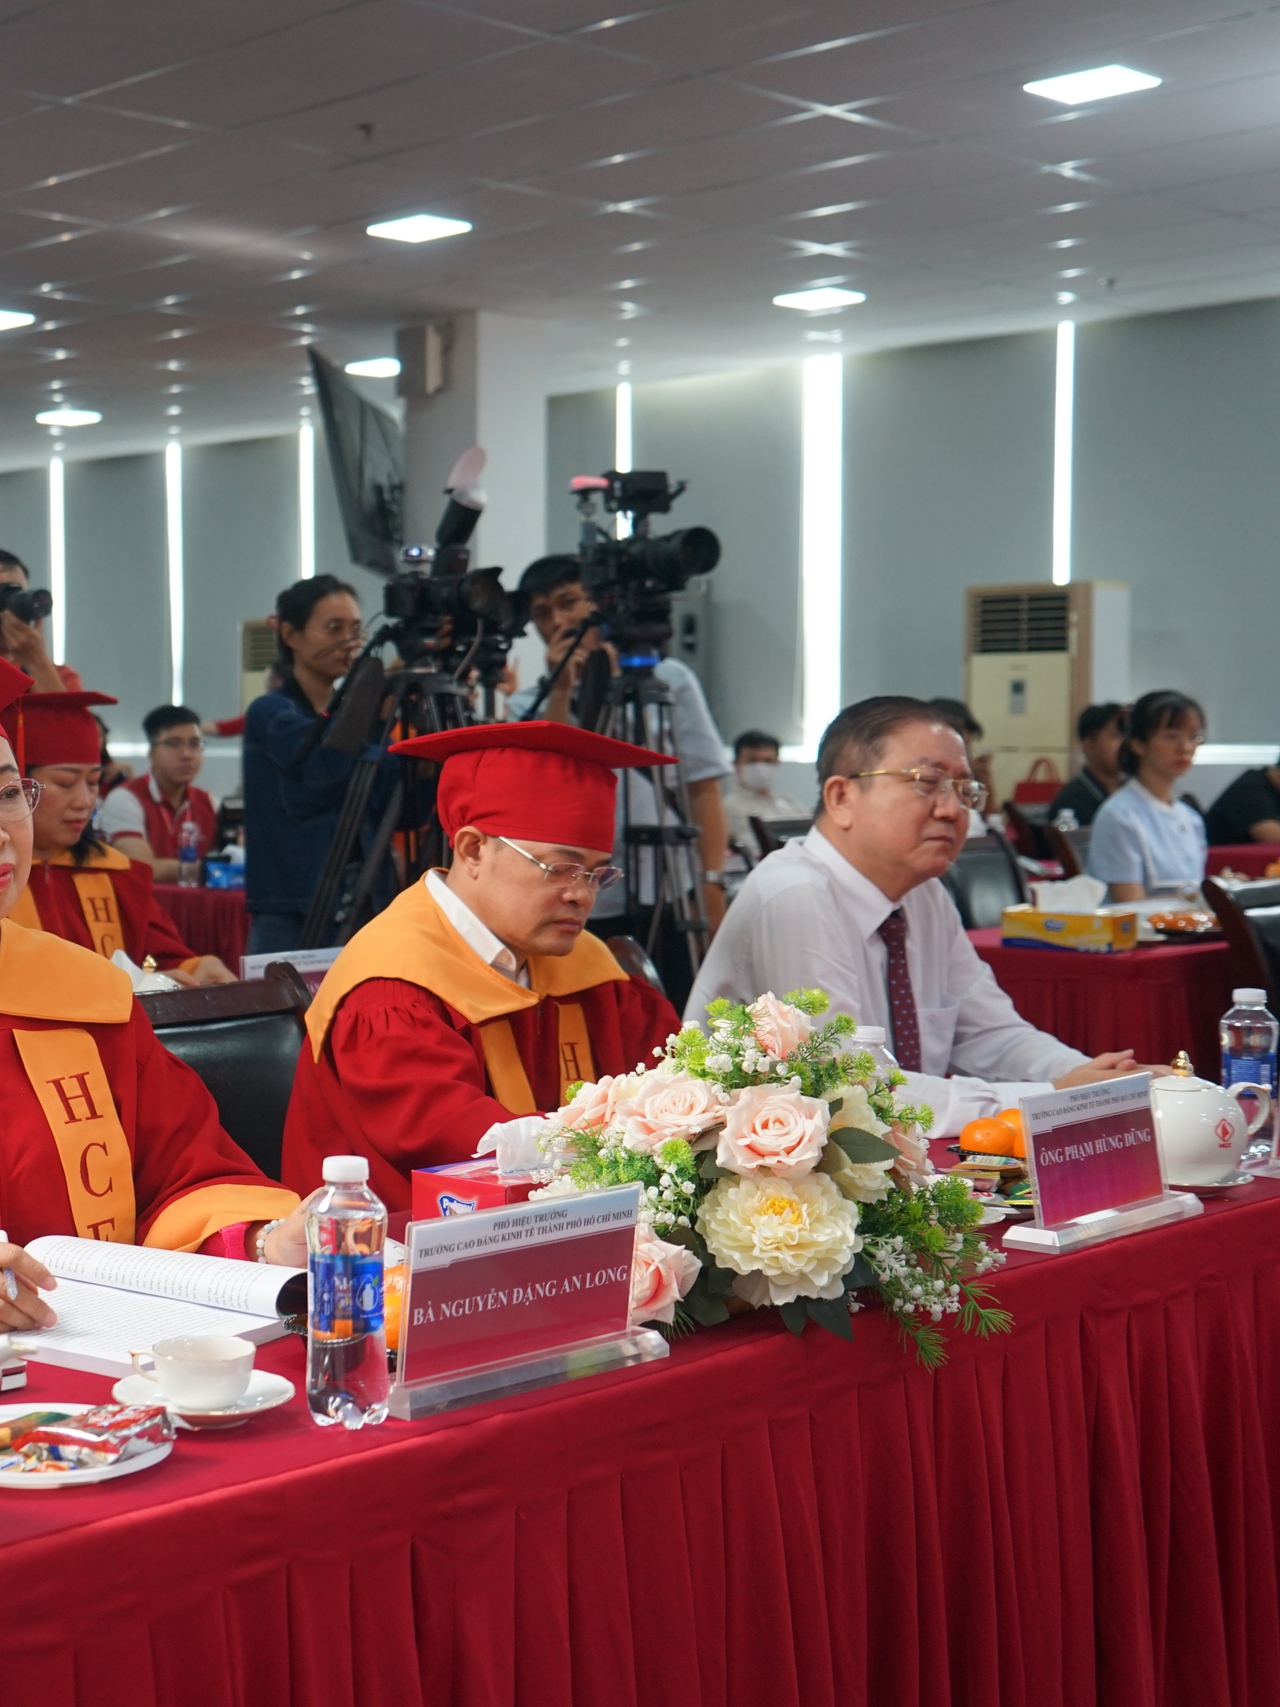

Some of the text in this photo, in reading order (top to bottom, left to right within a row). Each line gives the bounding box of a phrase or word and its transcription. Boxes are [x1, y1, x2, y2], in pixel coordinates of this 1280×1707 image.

[1040, 1127, 1152, 1167] ÔNG PHẠM HÙNG DŨNG
[456, 1238, 476, 1251] CAO
[501, 1229, 524, 1243] KINH
[536, 1222, 565, 1236] THÀNH
[596, 1210, 612, 1224] CHÍ
[612, 1208, 634, 1221] MINH
[492, 1216, 511, 1231] PHÓ
[511, 1213, 532, 1229] HIỆU
[412, 1264, 629, 1326] BÀ NGUYỄN ĐẶNG AN LONG
